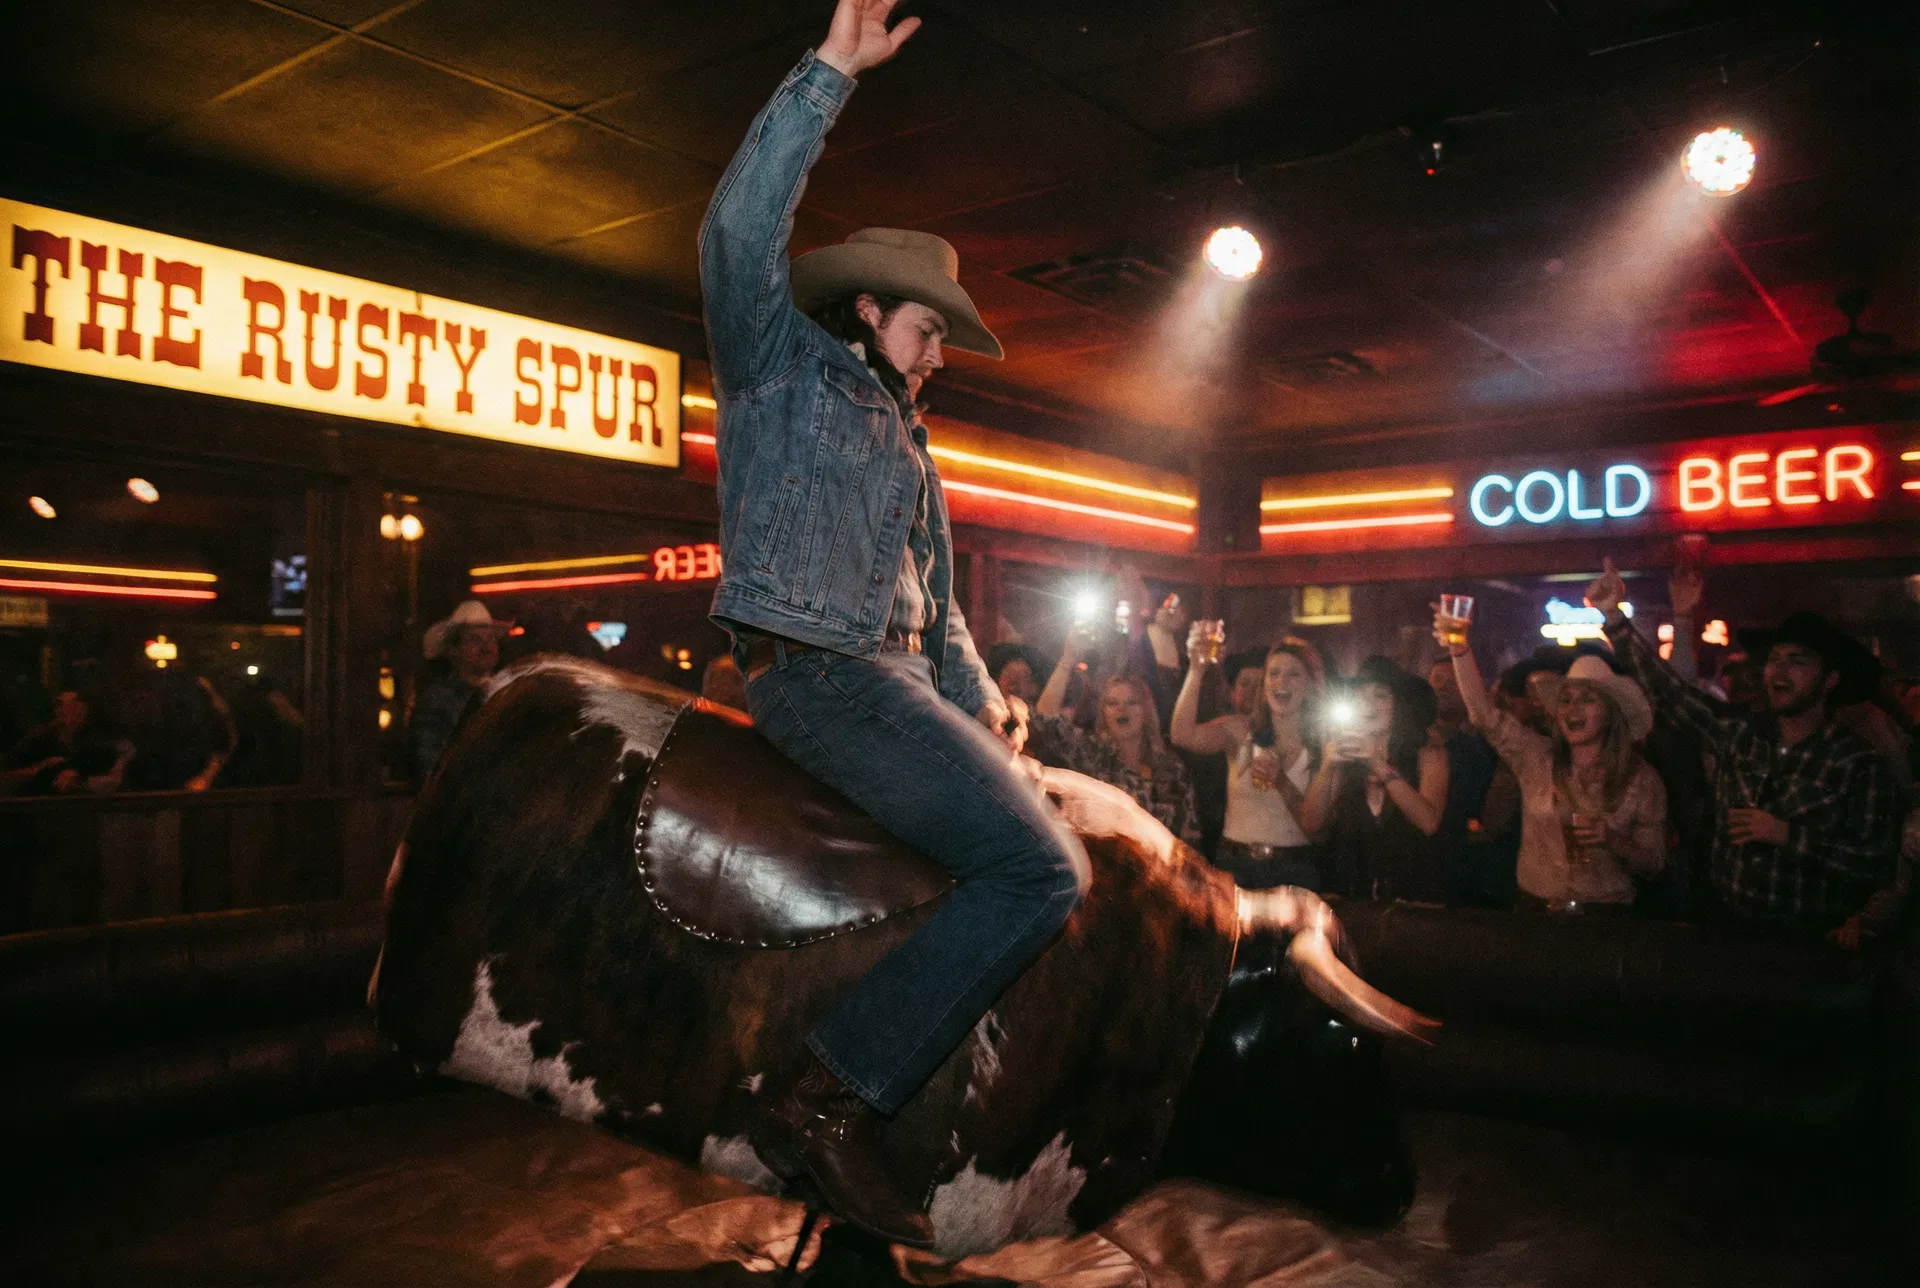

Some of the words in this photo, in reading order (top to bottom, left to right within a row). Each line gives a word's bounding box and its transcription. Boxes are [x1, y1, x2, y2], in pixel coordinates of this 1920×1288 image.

[12, 223, 203, 370] THE
[241, 276, 486, 414] RUSTY
[514, 337, 663, 447] SPUR
[1470, 464, 1651, 527] COLD
[1678, 445, 1875, 512] BEER
